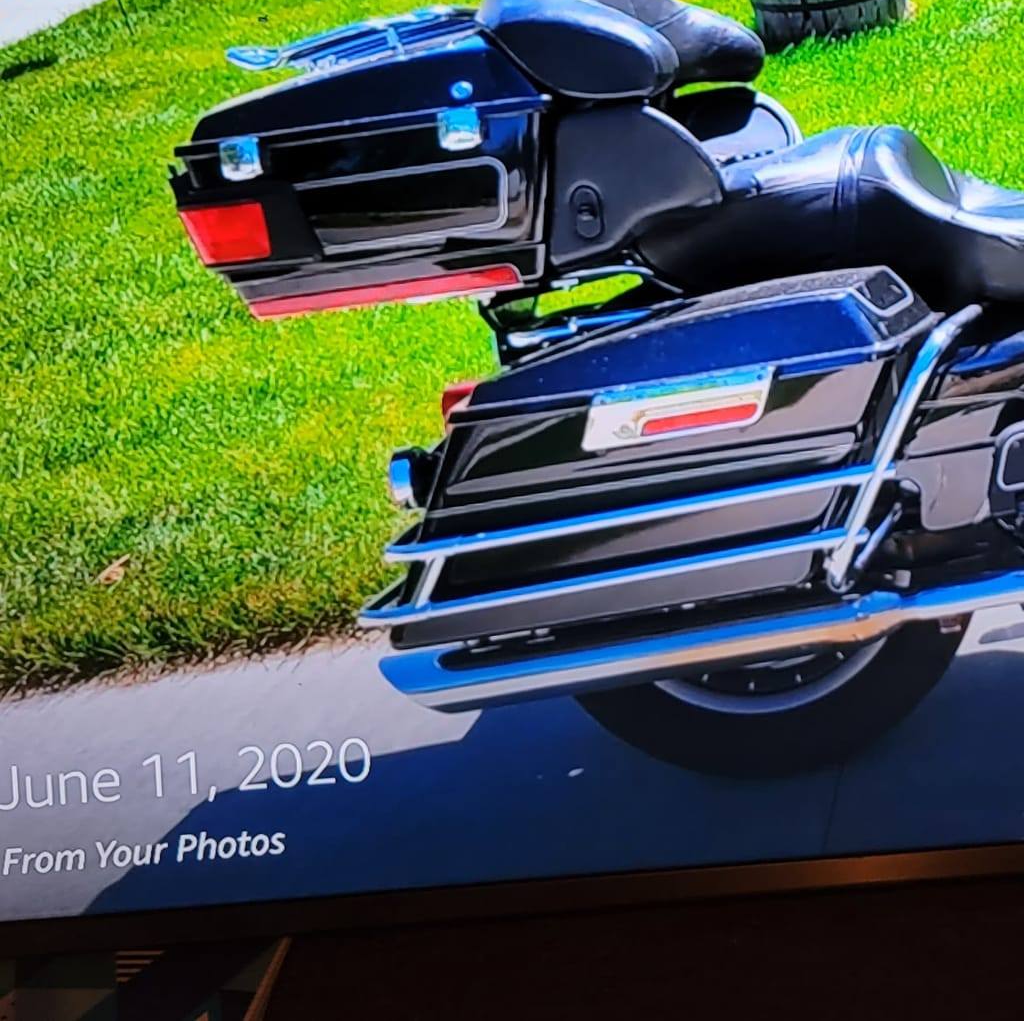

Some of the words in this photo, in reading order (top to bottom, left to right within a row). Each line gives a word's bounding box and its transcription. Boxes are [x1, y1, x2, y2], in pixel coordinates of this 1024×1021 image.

[0, 765, 121, 811] June
[142, 750, 217, 803] 11,
[237, 737, 372, 792] 2020
[2, 847, 86, 876] From
[95, 840, 169, 869] Your
[176, 830, 287, 863] Photos
